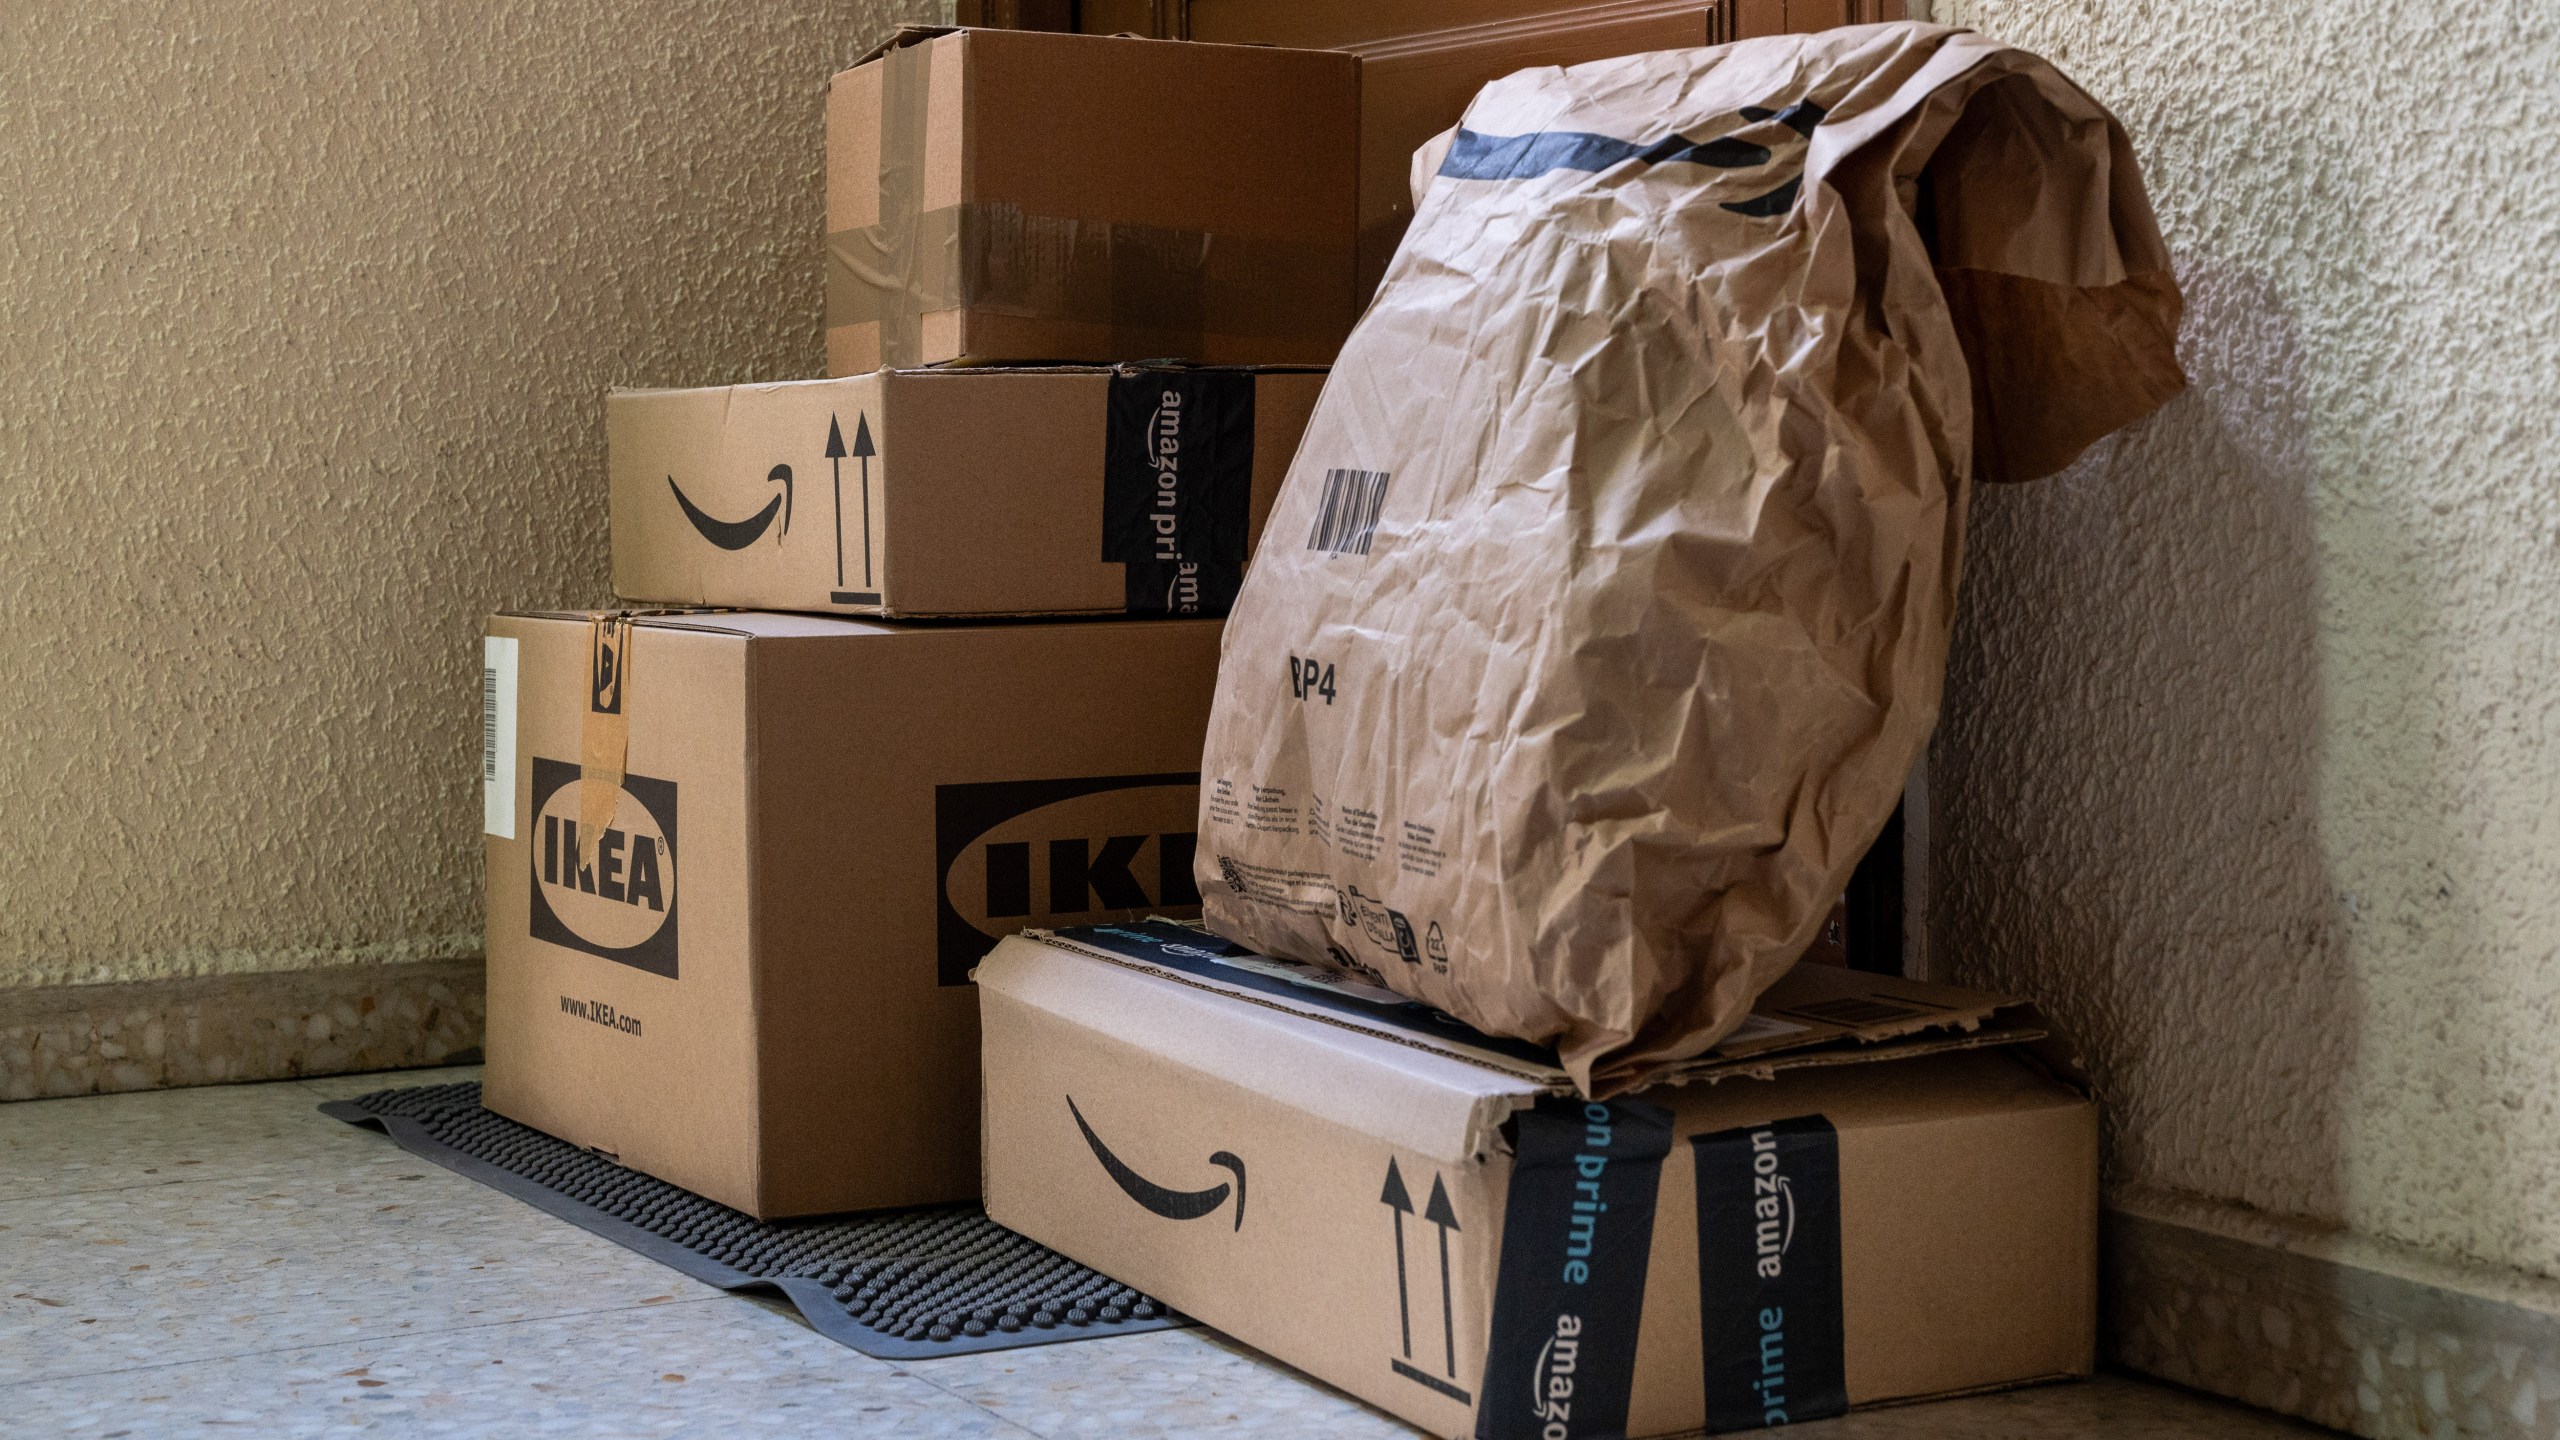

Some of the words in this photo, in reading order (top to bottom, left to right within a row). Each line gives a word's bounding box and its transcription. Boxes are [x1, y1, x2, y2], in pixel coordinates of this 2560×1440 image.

[1157, 390, 1181, 507] amazon
[1150, 514, 1182, 560] pri
[1290, 656, 1336, 705] BP4
[560, 995, 642, 1037] www.IKEA.com
[1563, 1155, 1609, 1285] prime
[1751, 1129, 1782, 1278] amazon
